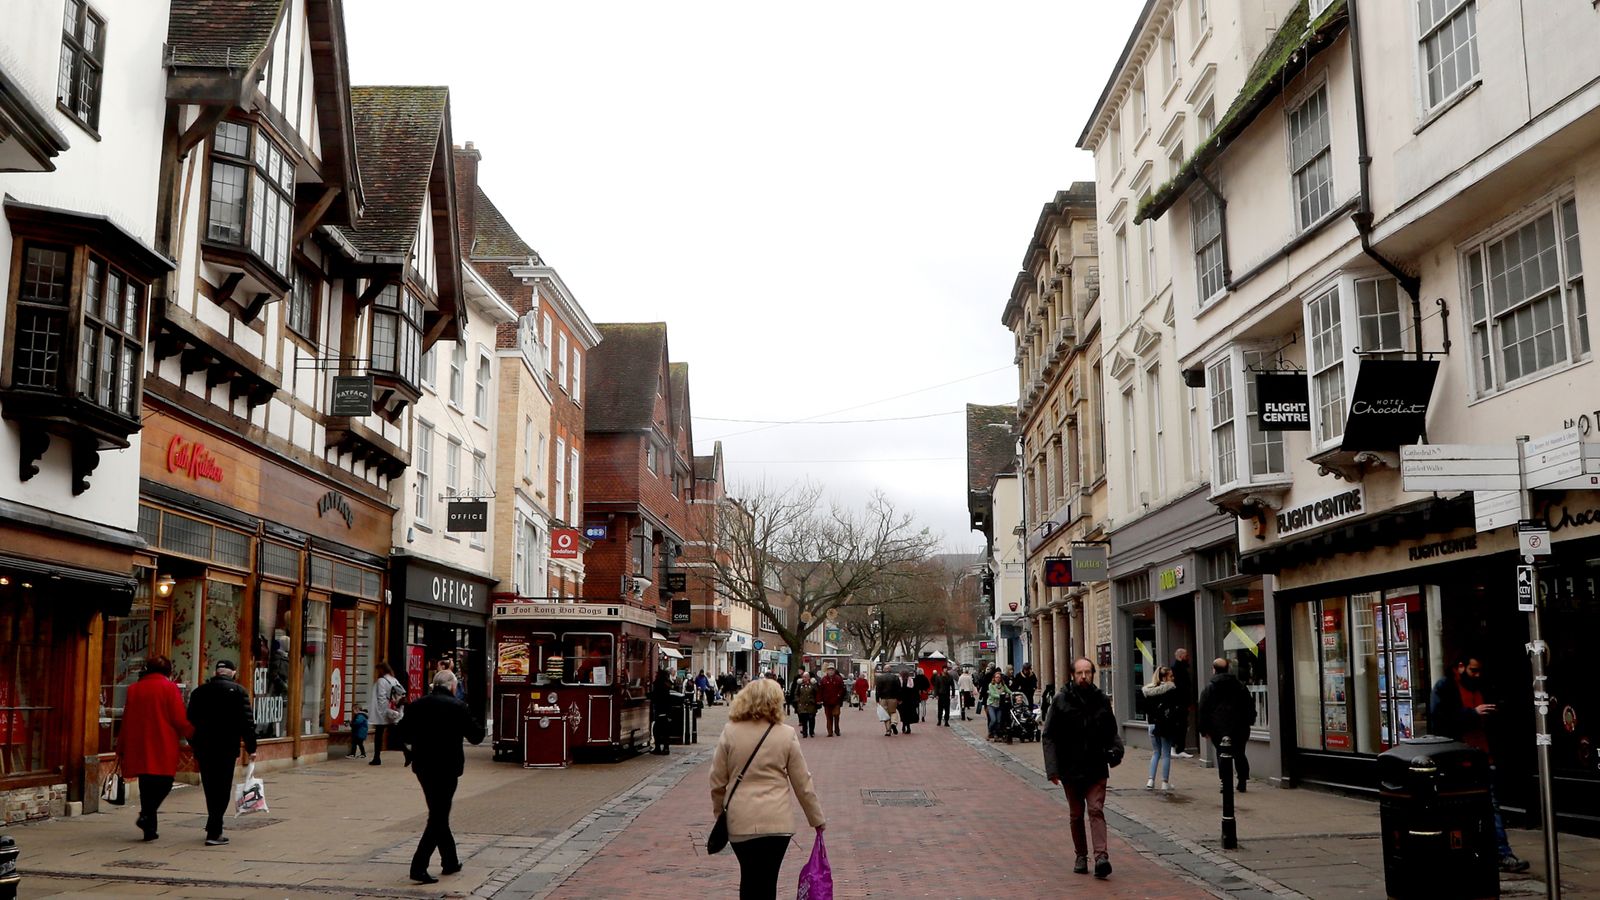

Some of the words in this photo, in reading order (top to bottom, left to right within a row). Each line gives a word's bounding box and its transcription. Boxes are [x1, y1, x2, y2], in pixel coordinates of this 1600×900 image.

[336, 389, 368, 399] FATFACE
[1262, 412, 1309, 422] CENTRE
[1264, 402, 1307, 412] FLIGHT
[317, 490, 353, 529] FATFACE
[1276, 504, 1314, 534] FLIGHT
[1314, 488, 1362, 522] CENTRE
[1408, 542, 1440, 561] FLIGHT
[1440, 535, 1478, 555] CENTRE
[432, 576, 473, 608] OFFICE
[1519, 586, 1531, 594] CCTV
[511, 606, 531, 615] Foot
[534, 606, 556, 615] Long
[578, 606, 602, 615] Dogs
[254, 667, 268, 694] GET
[409, 673, 421, 690] SALE
[253, 695, 283, 724] LAYERED
